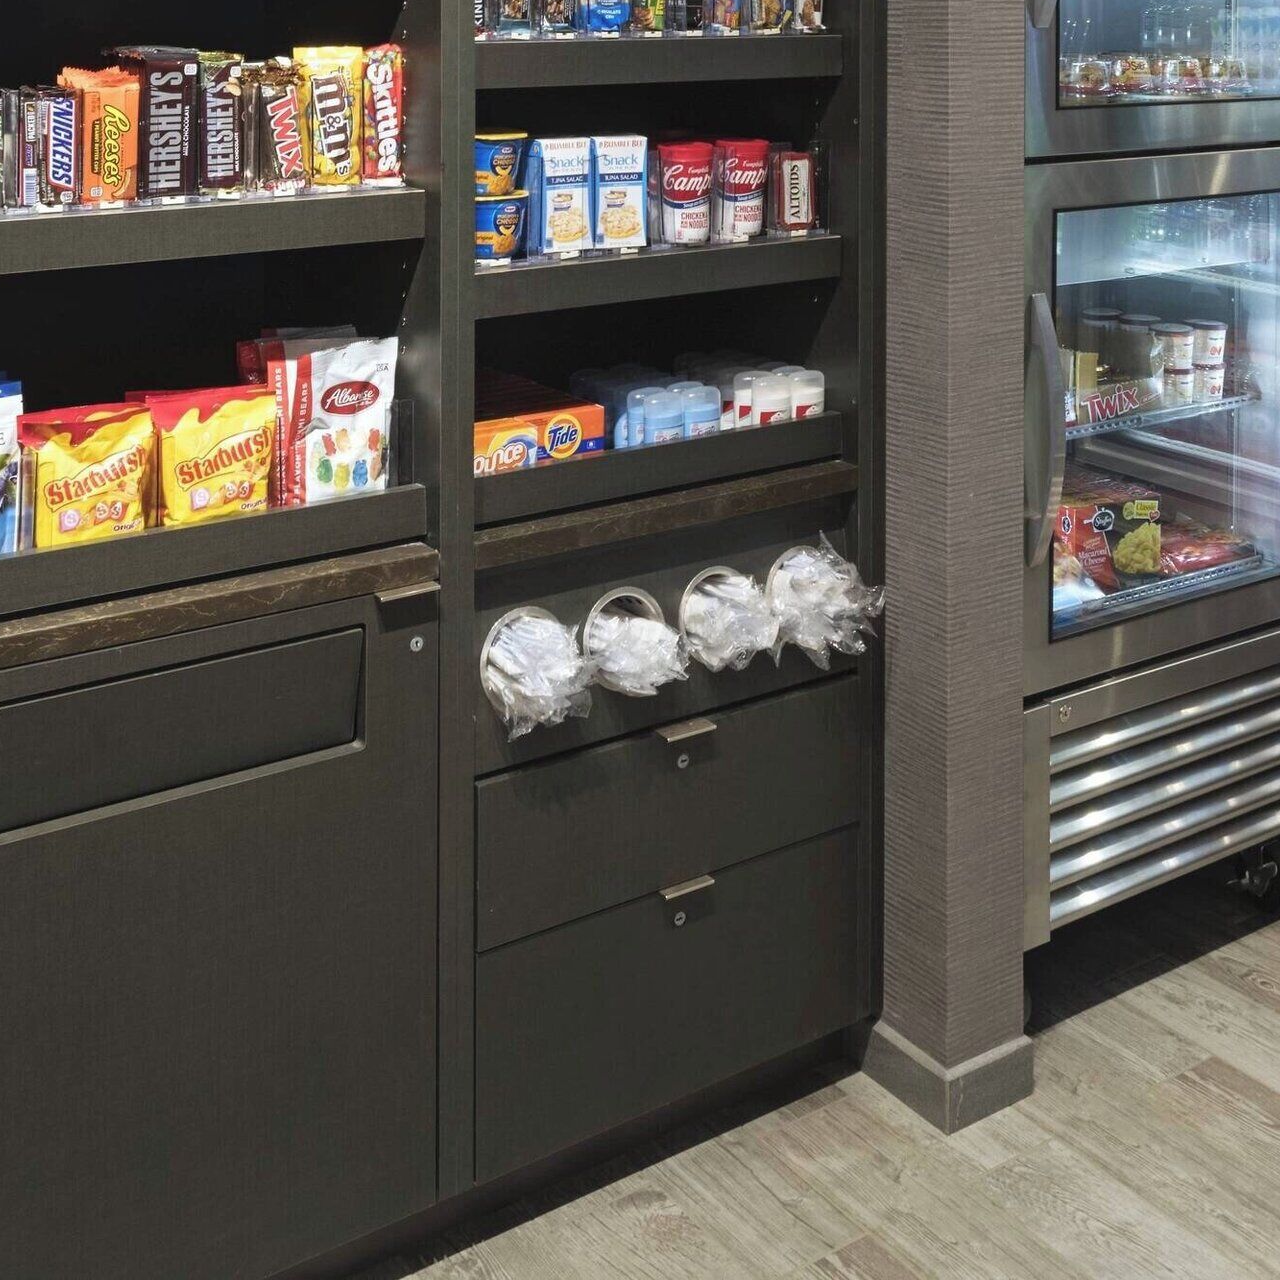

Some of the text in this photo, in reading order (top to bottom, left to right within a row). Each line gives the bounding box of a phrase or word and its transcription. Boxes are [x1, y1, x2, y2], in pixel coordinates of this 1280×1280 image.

[50, 98, 74, 186] SNICKERS
[104, 104, 131, 187] Reese's
[148, 70, 183, 189] HERSHEY'S
[206, 79, 235, 178] HERSHEY'S
[268, 87, 303, 177] TWIX
[367, 62, 400, 172] Skittles
[550, 156, 584, 169] Snack
[604, 153, 639, 166] Snack
[789, 164, 801, 219] ALTOIDS
[324, 387, 375, 410] Albanese
[1081, 384, 1140, 423] Twix
[176, 425, 271, 485] Starburst
[548, 422, 579, 451] Tide
[46, 444, 148, 506] Starburst
